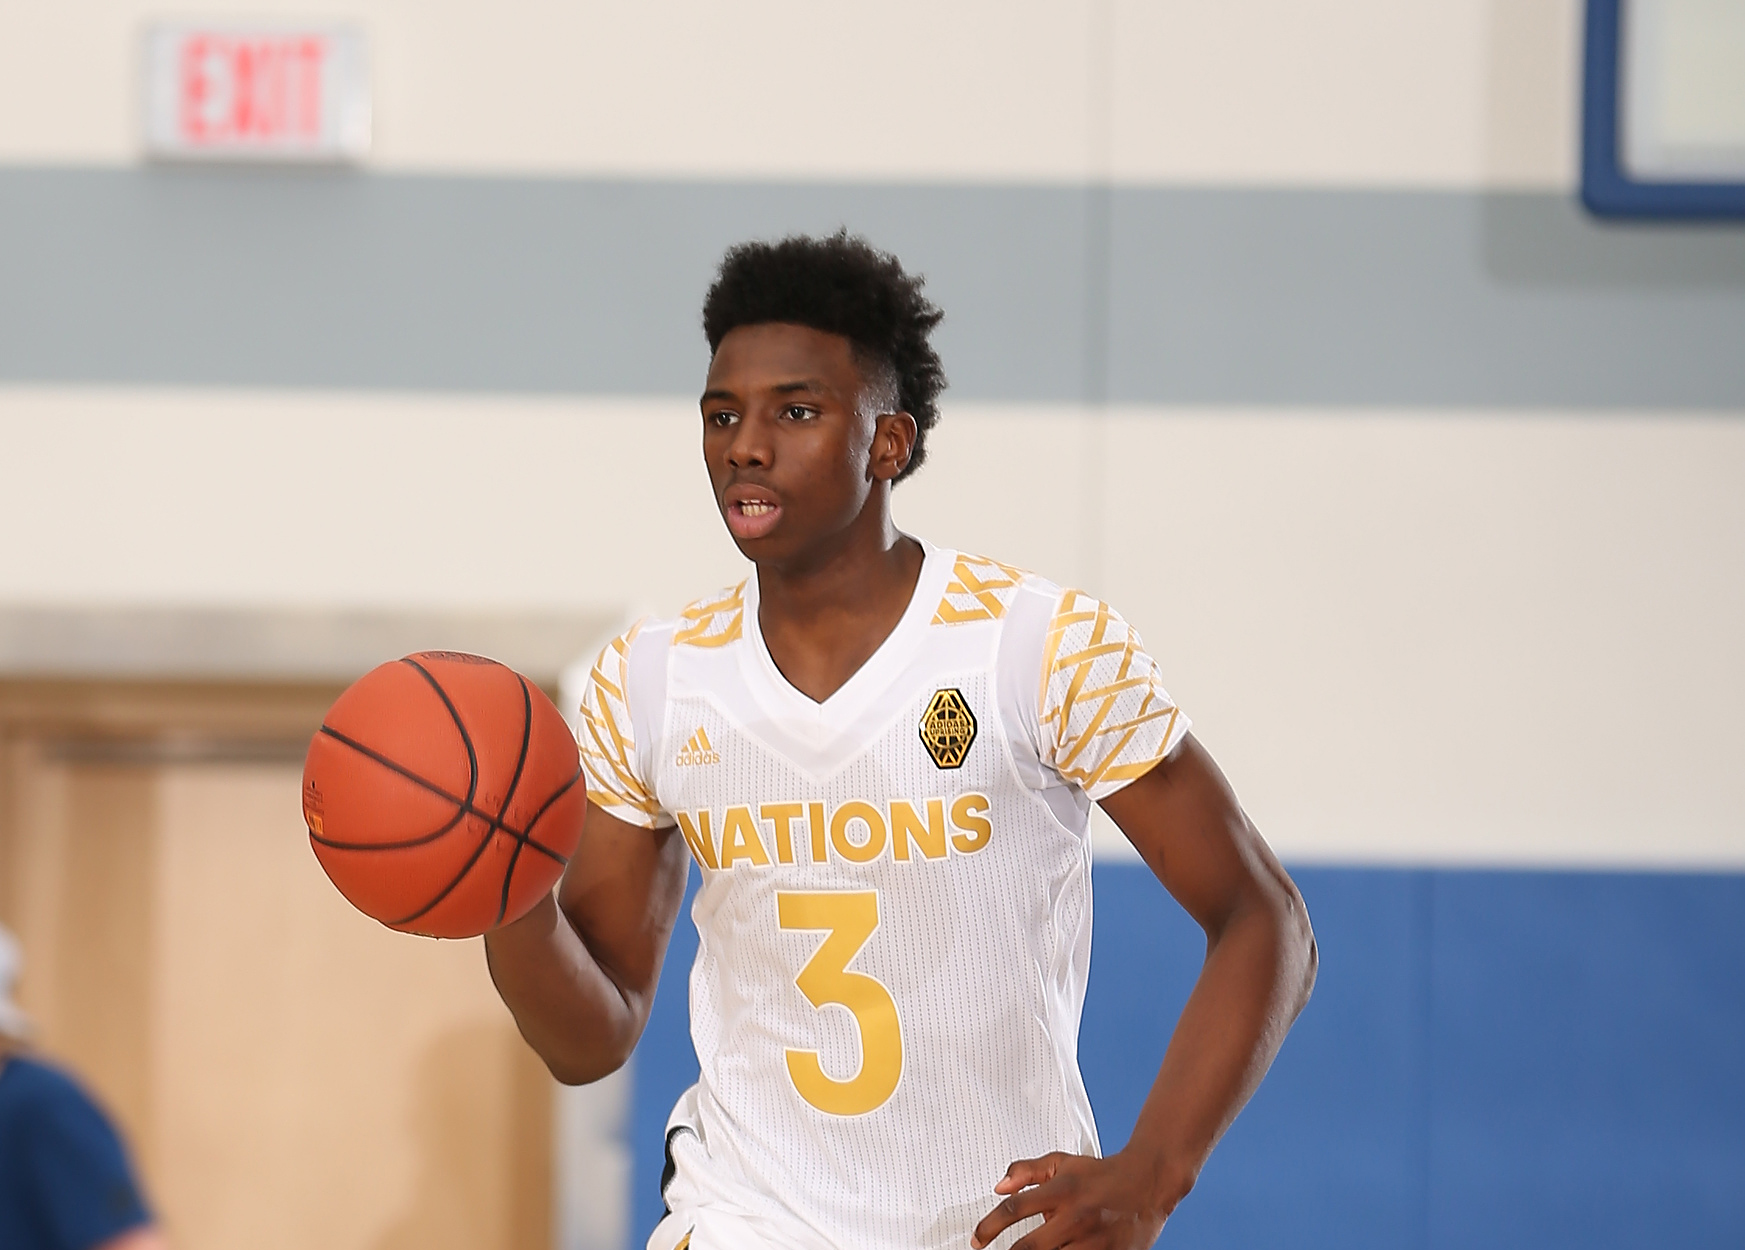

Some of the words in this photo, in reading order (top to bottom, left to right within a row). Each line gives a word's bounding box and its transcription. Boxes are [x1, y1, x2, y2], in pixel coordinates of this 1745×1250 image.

[178, 34, 323, 143] EXIT
[676, 751, 721, 767] adidas
[930, 720, 965, 729] ADIDAS
[676, 792, 993, 871] NATIONS
[775, 889, 906, 1117] 3
